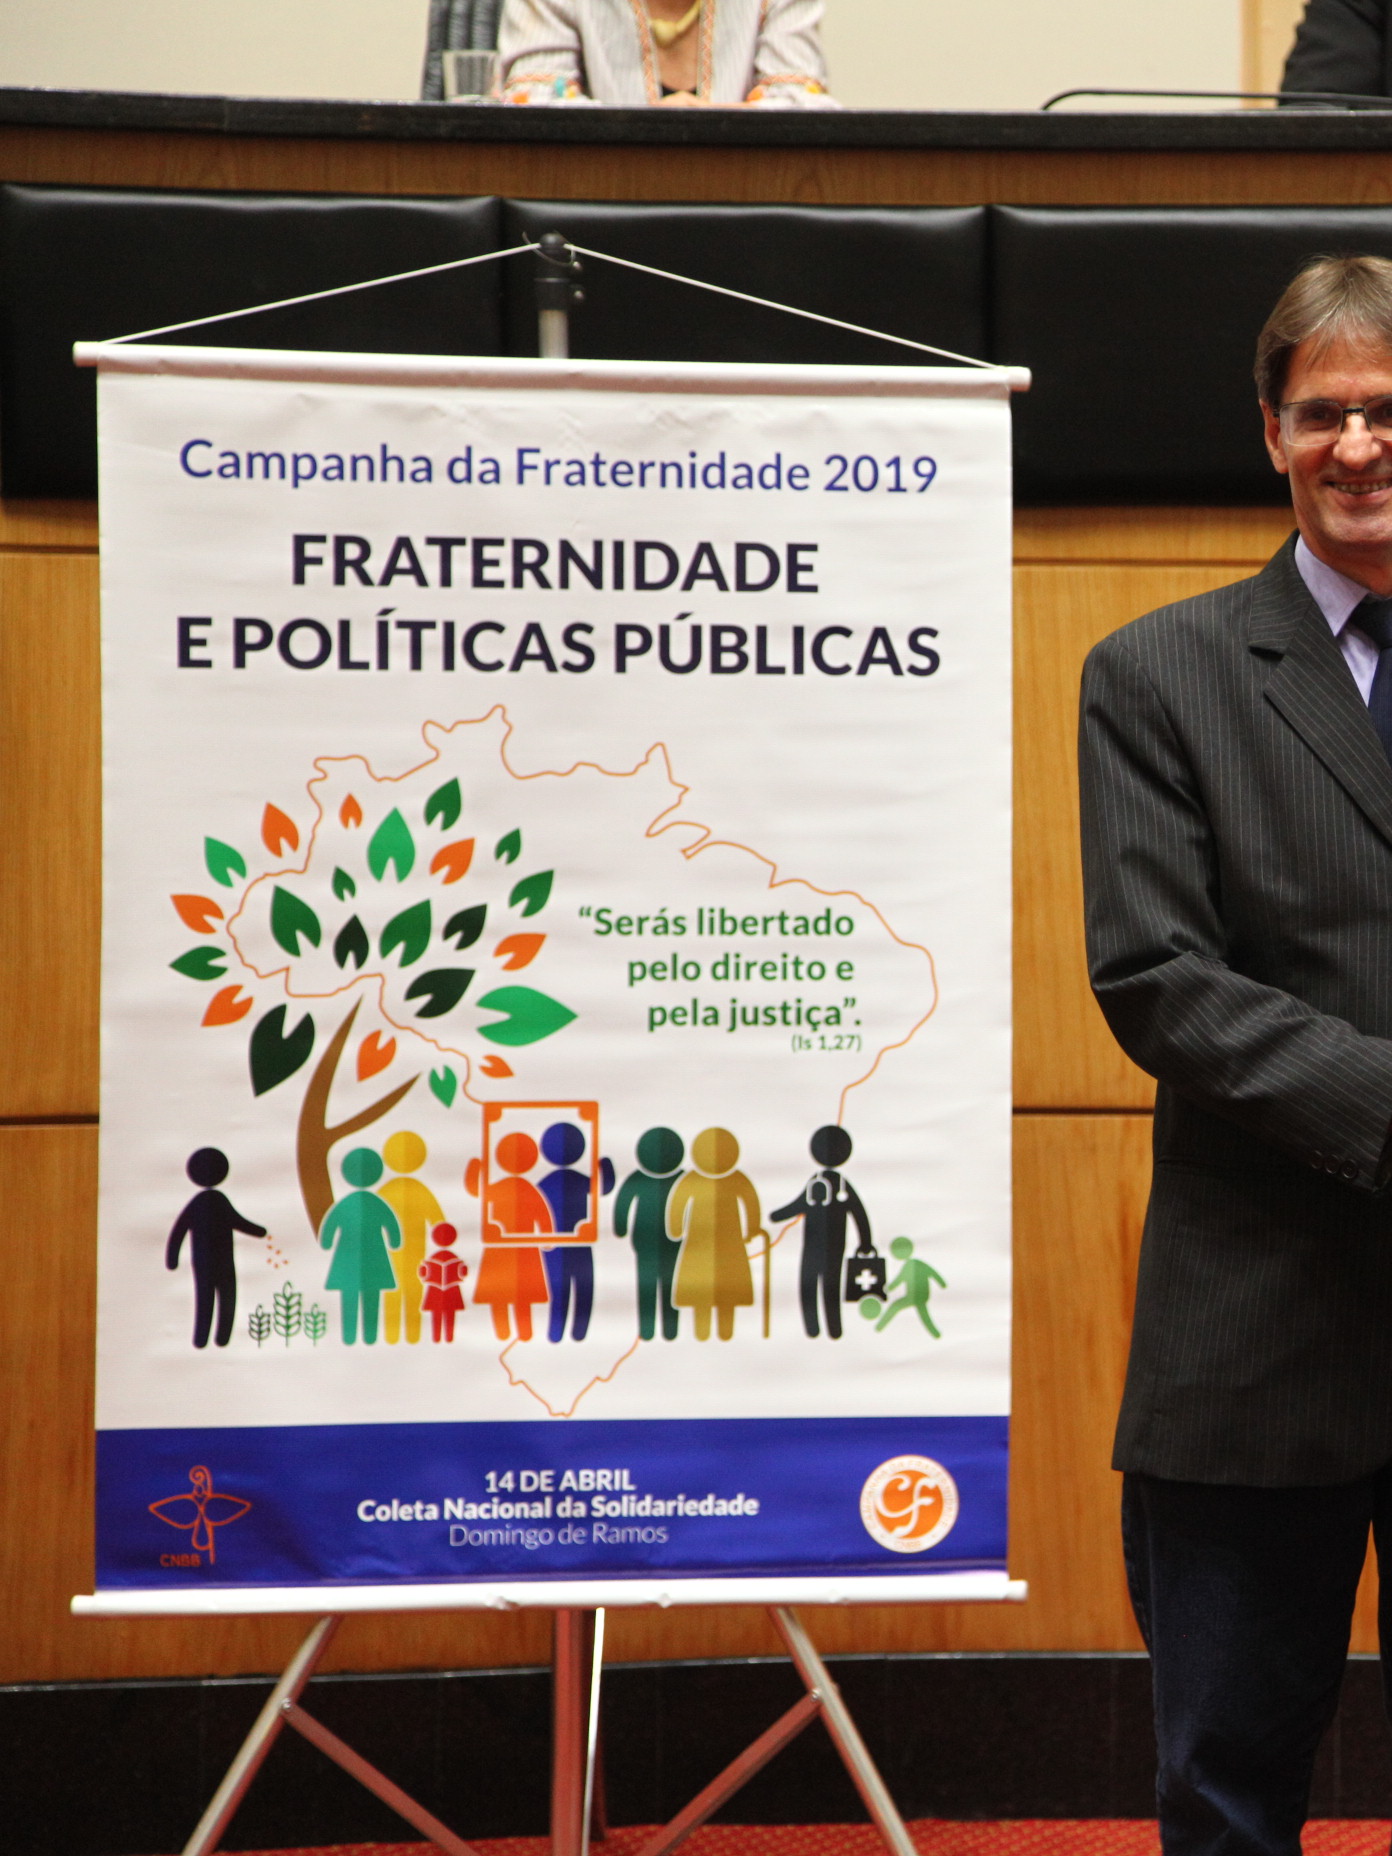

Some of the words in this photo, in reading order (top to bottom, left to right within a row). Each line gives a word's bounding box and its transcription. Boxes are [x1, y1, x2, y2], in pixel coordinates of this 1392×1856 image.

[181, 439, 432, 489] Campanha
[447, 445, 500, 485] da
[517, 448, 810, 491] Fraternidade
[824, 454, 938, 493] 2019
[293, 534, 819, 593] FRATERNIDADE
[177, 616, 212, 668] E
[233, 609, 596, 674] POLÍTICAS
[615, 612, 940, 677] PÚBLICAS
[698, 907, 854, 936] libertado
[629, 952, 701, 987] pelo
[711, 953, 826, 981] direito
[836, 961, 854, 981] e
[649, 998, 719, 1033] pela
[819, 1034, 862, 1053] 1,27)
[485, 1470, 515, 1493] 14
[520, 1470, 554, 1492] DE
[559, 1468, 637, 1492] ABRIL
[356, 1499, 439, 1522] Coleta
[443, 1497, 552, 1520] Nacional
[556, 1496, 587, 1518] da
[590, 1493, 761, 1518] Solidariedade
[449, 1523, 554, 1551] Domingo
[558, 1522, 588, 1546] de
[592, 1522, 669, 1545] Ramos
